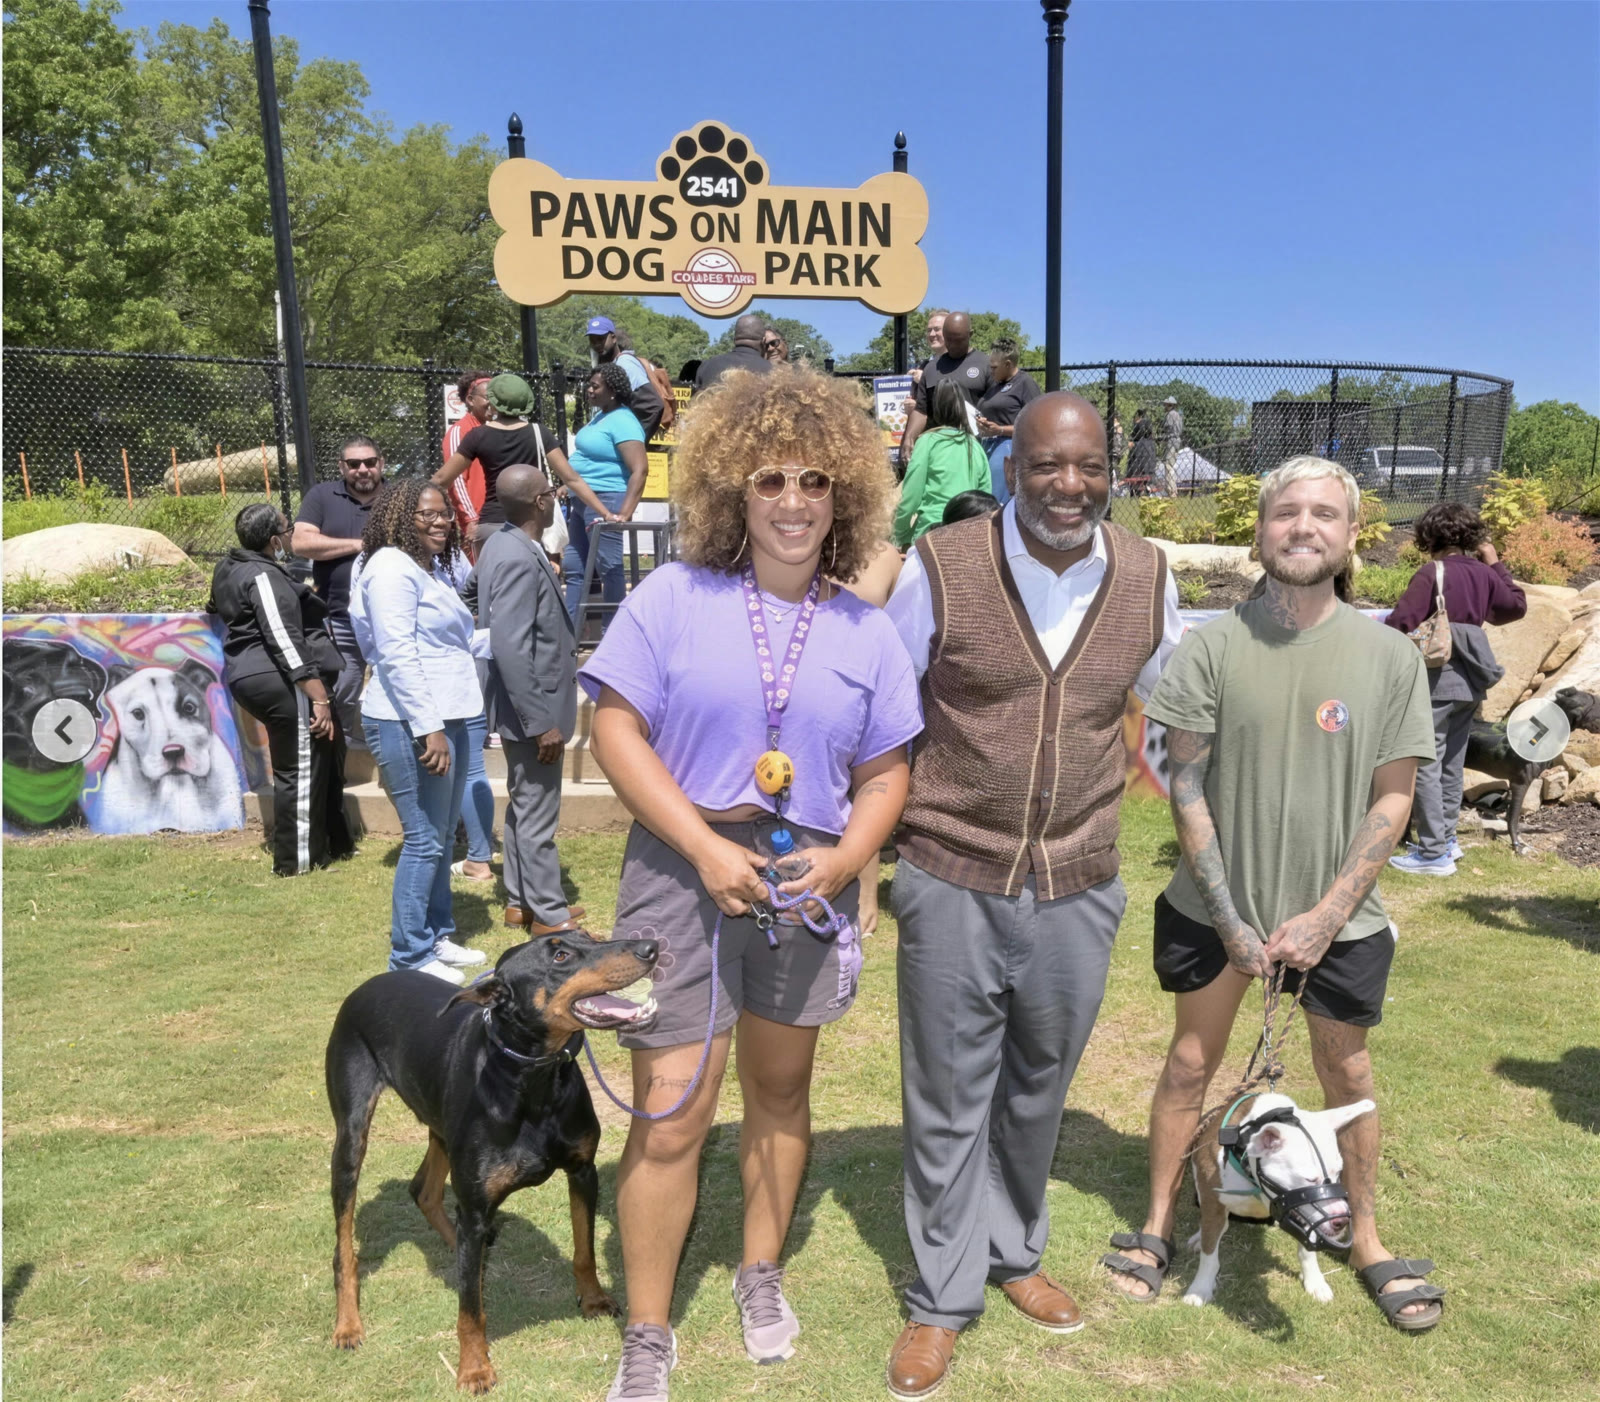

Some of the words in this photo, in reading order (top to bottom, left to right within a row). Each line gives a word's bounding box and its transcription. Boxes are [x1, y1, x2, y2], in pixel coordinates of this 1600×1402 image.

[687, 176, 738, 198] 2541
[530, 190, 678, 242] PAWS
[690, 211, 741, 244] ON
[756, 198, 891, 248] MAIN
[561, 245, 665, 282] DOG
[764, 251, 882, 288] PARK
[883, 402, 897, 412] 72
